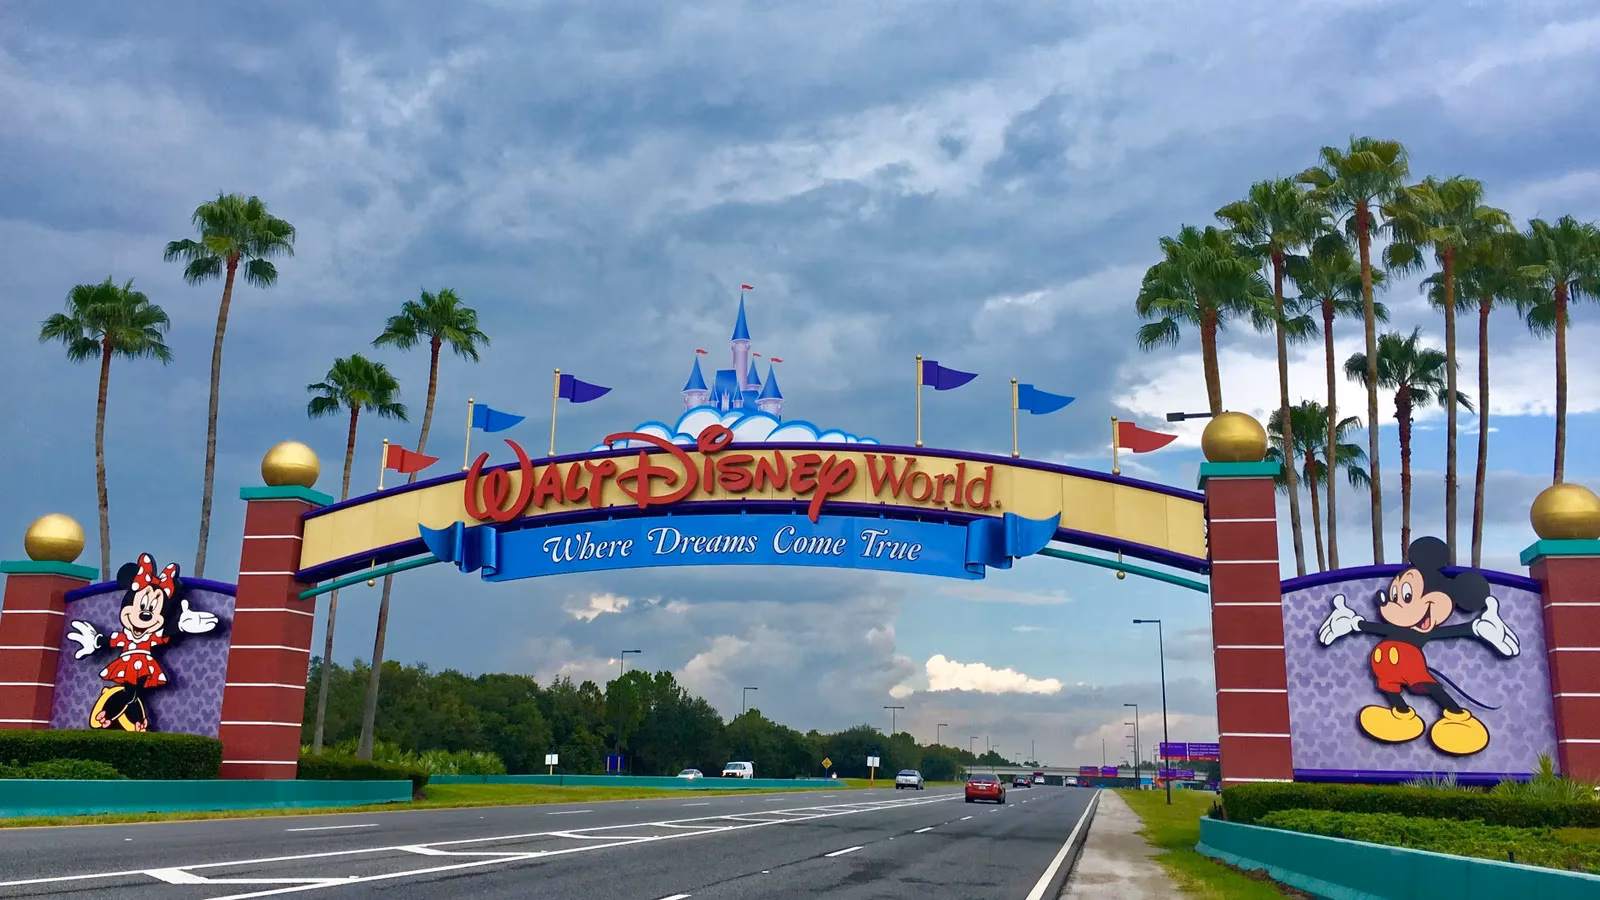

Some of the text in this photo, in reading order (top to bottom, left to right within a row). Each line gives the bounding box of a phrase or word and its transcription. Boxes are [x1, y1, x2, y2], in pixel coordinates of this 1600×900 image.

[542, 525, 923, 563] Where Dreams Come True
